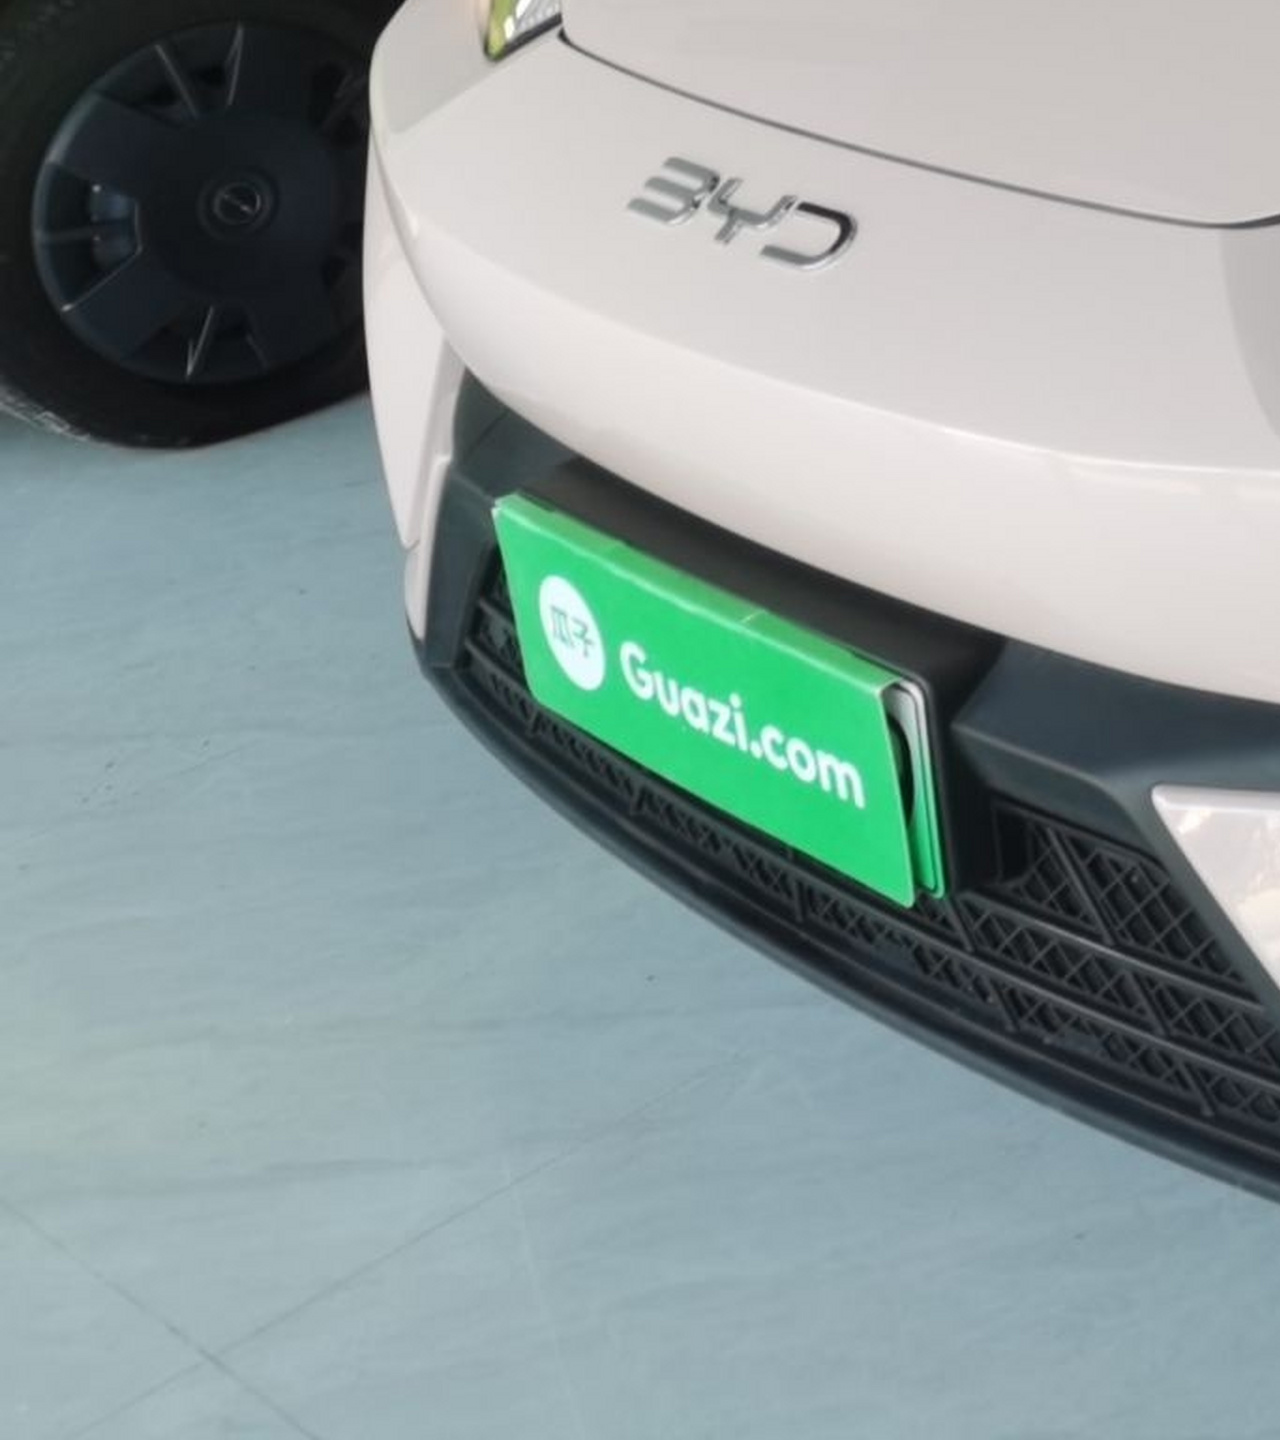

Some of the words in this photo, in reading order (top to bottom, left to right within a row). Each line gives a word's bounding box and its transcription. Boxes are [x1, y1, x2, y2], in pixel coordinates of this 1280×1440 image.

[626, 157, 859, 269] BYD
[549, 604, 596, 658] 瓜子
[619, 640, 866, 810] Guazi.com
